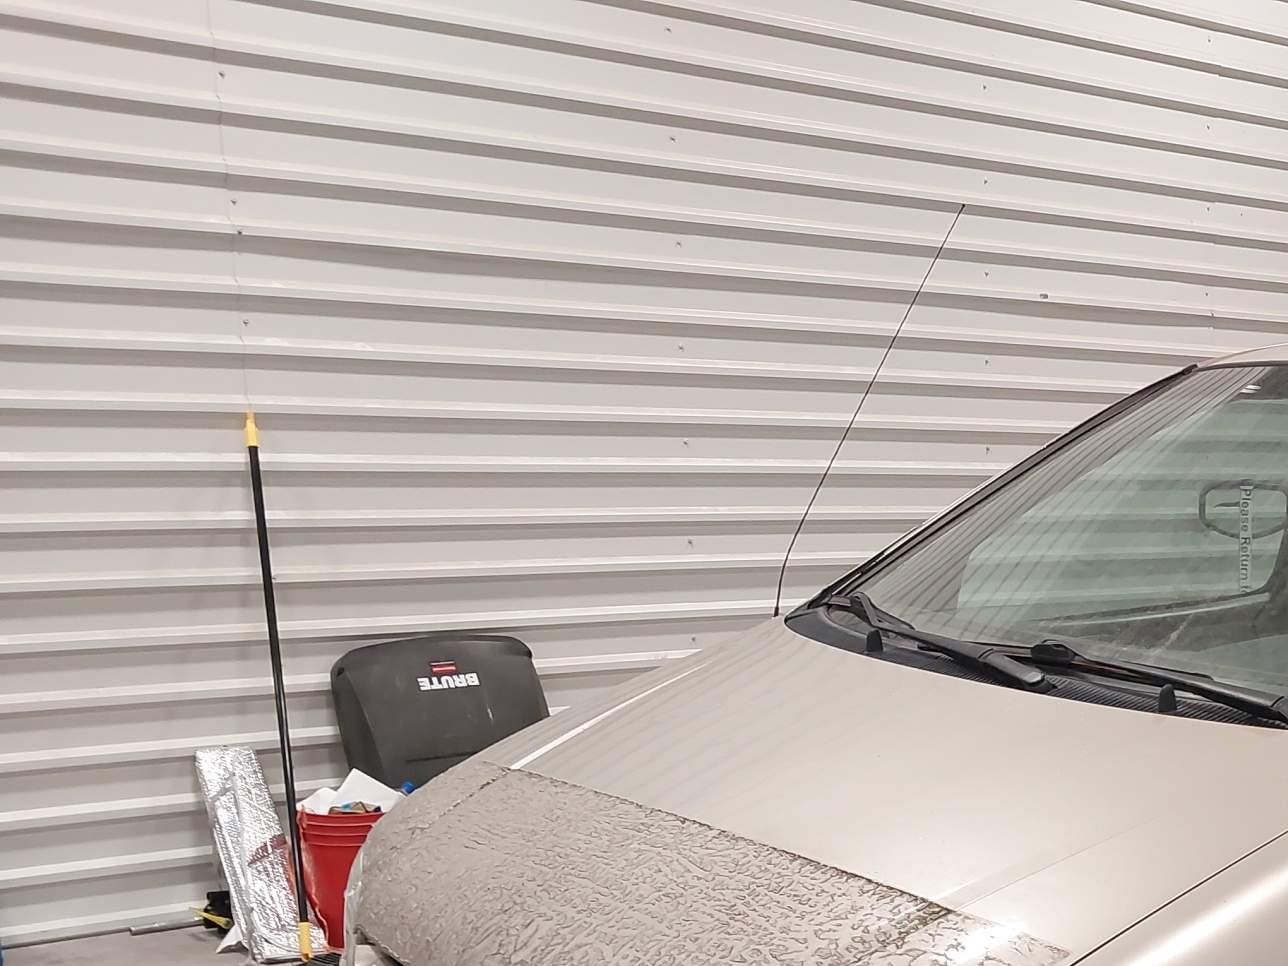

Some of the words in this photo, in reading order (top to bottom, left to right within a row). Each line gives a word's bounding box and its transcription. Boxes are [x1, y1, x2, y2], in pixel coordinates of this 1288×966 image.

[1240, 487, 1253, 532] Please
[1240, 537, 1252, 582] Return
[417, 672, 480, 691] BRUTE
